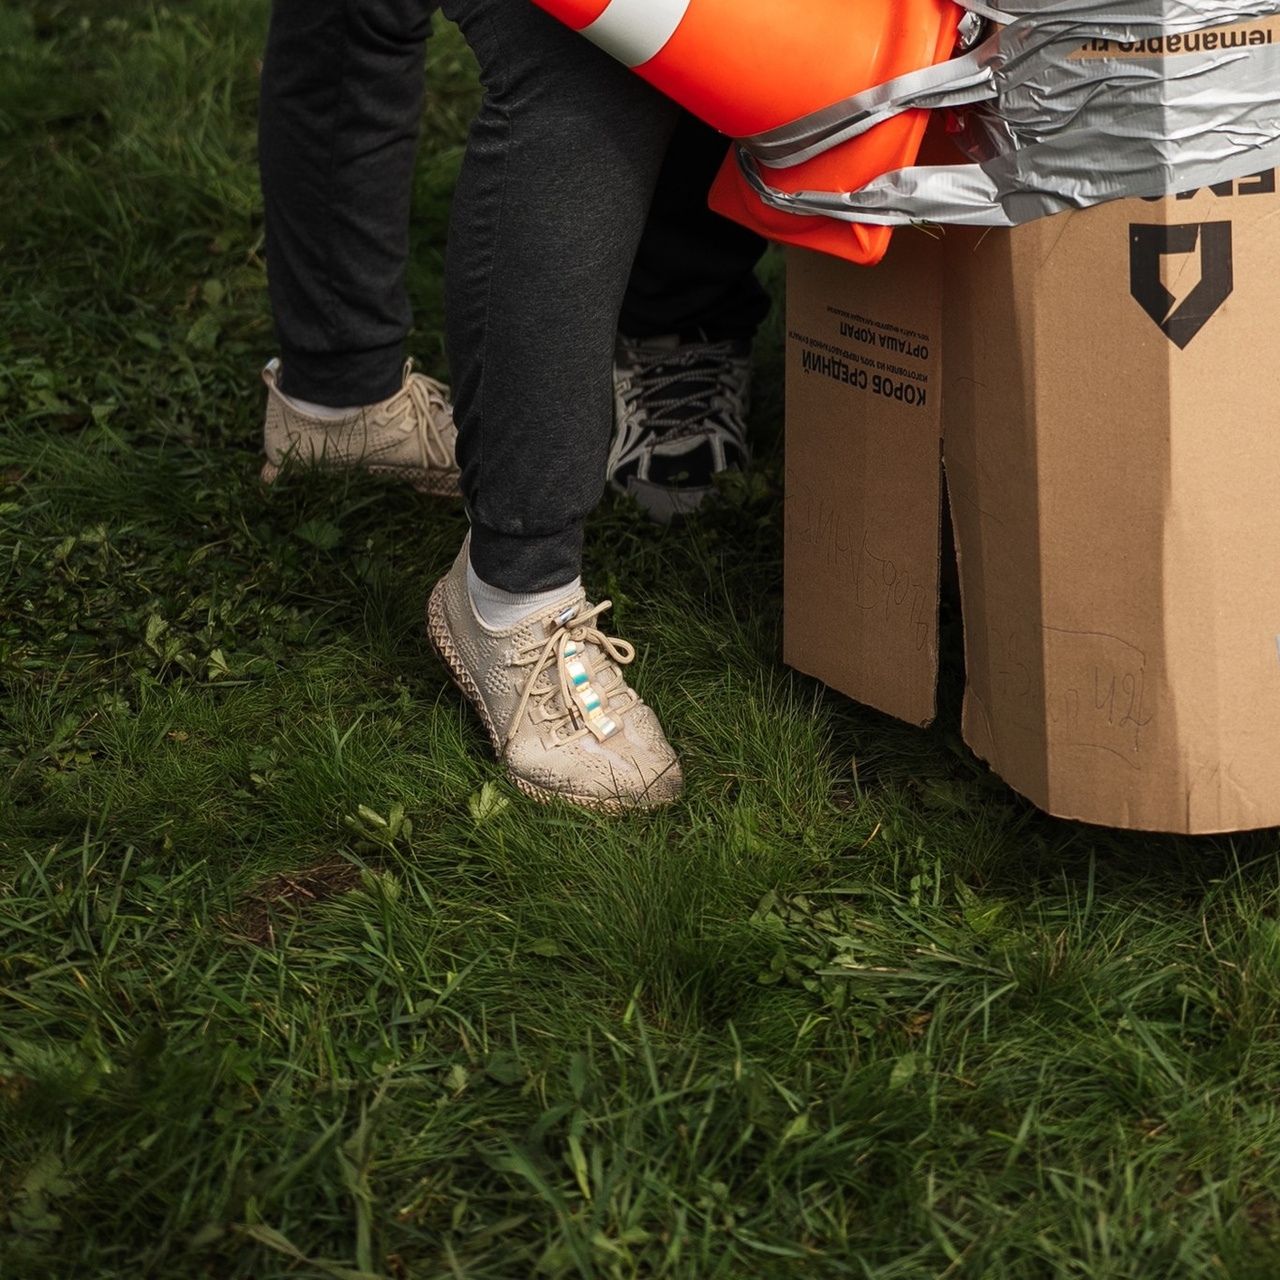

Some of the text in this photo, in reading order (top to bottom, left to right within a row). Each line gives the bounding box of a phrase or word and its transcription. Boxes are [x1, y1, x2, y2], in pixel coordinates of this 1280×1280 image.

[878, 333, 929, 360] ОРТАША
[802, 348, 927, 407] КОРОБ СРЕДНИЙ
